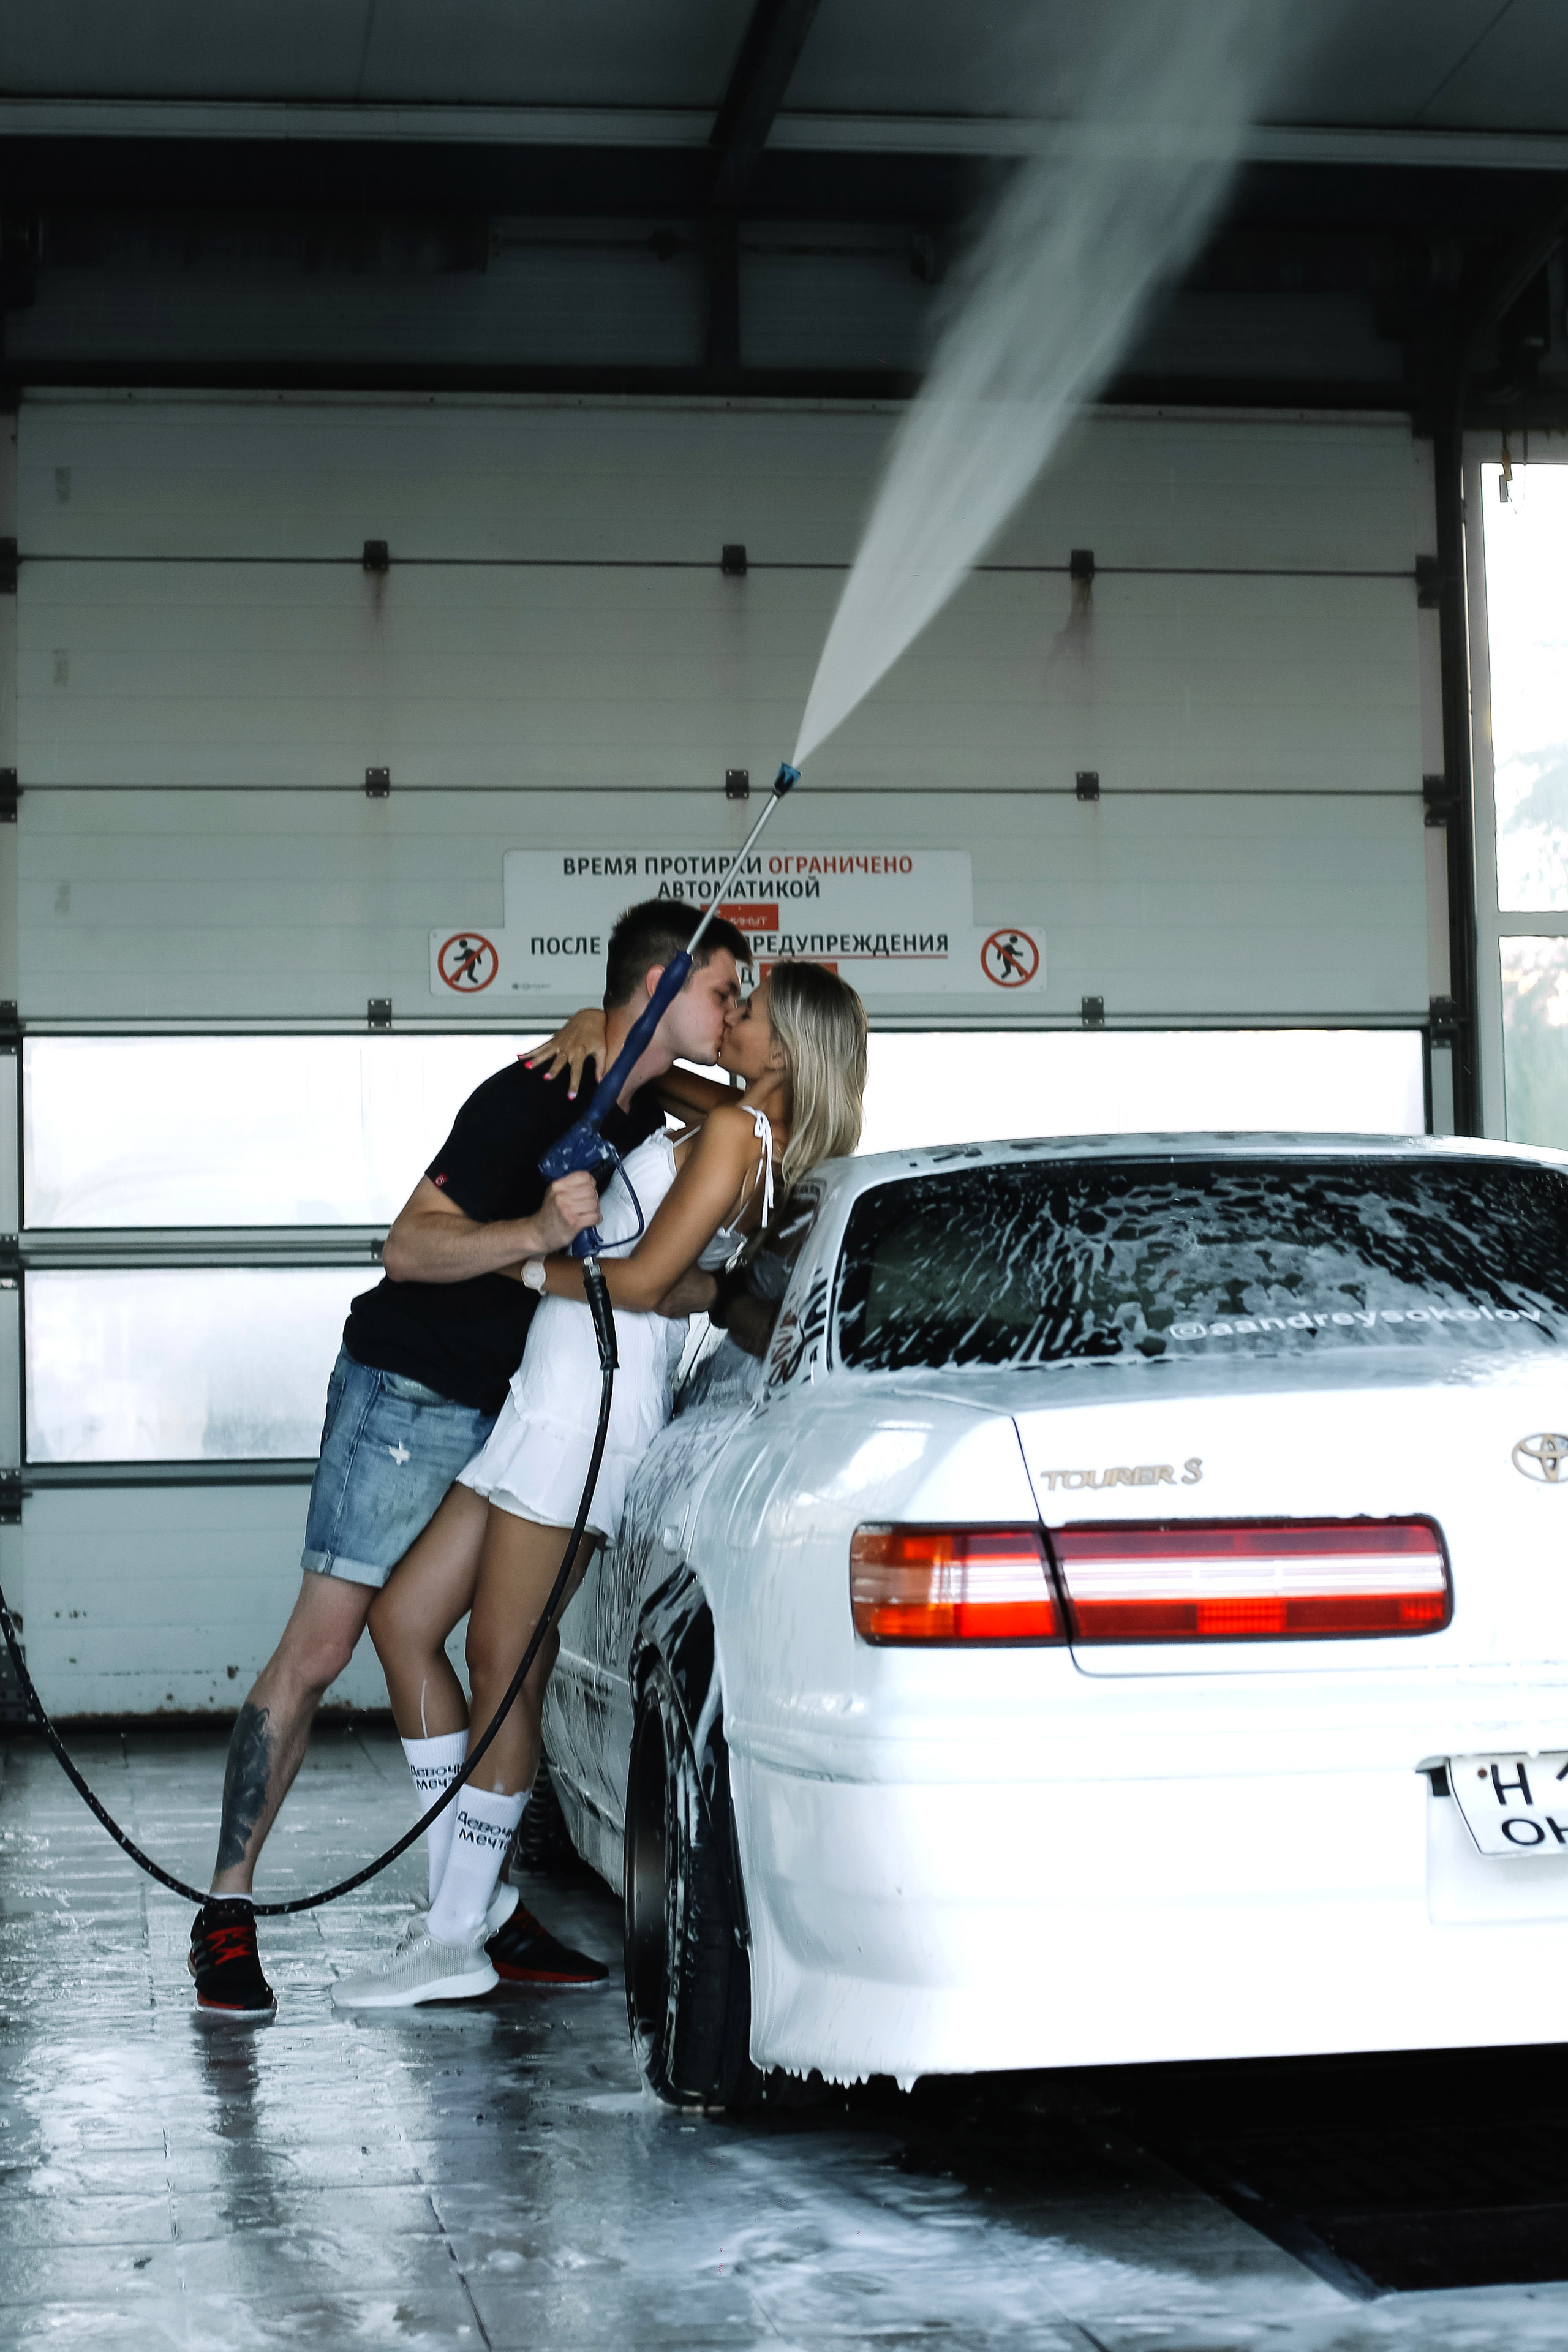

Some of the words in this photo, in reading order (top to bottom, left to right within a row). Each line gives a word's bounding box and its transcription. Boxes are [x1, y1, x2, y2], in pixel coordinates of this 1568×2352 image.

[563, 856, 636, 876] ВРЕМЯ
[769, 855, 913, 875] ОГРАНИЧЕНО
[530, 936, 601, 955] ПОСЛЕ
[745, 933, 948, 957] РЕДУПРЕЖДЕНИЯ
[1040, 1464, 1177, 1491] TOURER
[1180, 1457, 1203, 1485] S
